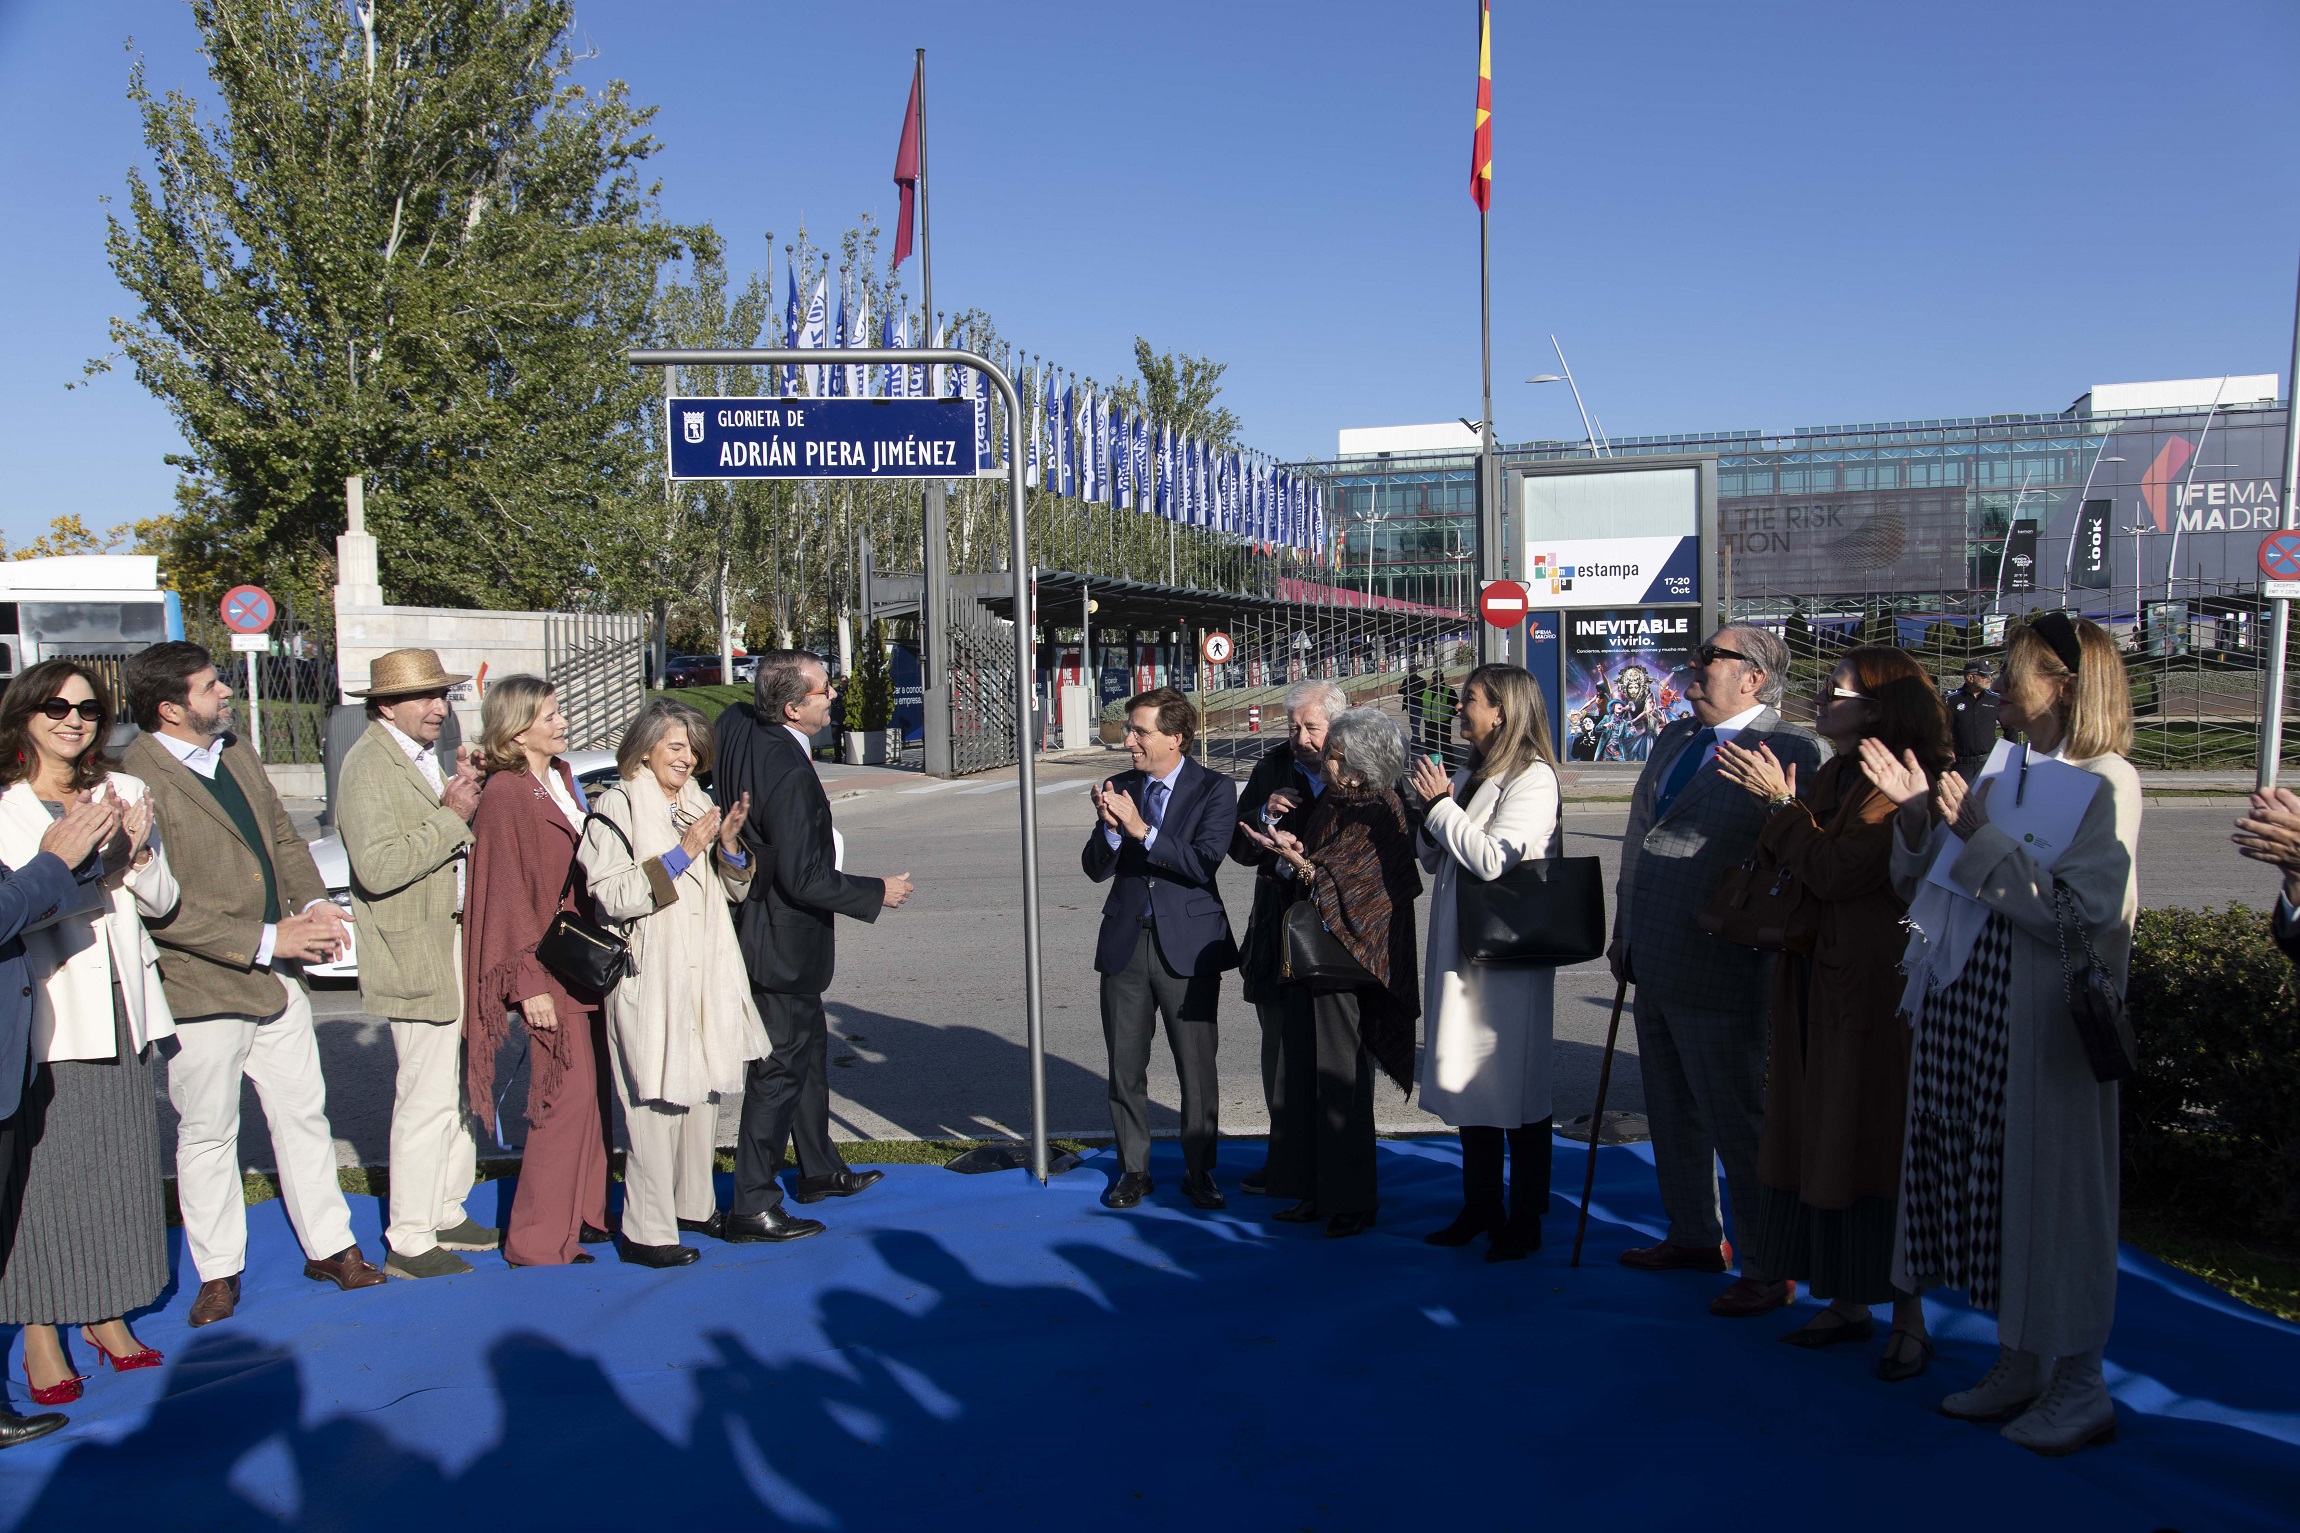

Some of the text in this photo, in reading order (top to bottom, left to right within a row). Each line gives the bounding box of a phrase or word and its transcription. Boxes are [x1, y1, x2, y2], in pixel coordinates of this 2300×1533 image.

[718, 409, 805, 428] GLORIETA DE
[719, 435, 957, 473] ADRIÁN PIERA JIMÉNEZ
[2176, 481, 2278, 507] IFEMA
[1735, 508, 1776, 531] THE
[1786, 504, 1844, 529] RISK
[2091, 518, 2103, 571] LOOK
[1578, 563, 1639, 580] estampa
[1663, 577, 1690, 586] 17-20
[1670, 586, 1691, 595] Oct
[1576, 618, 1688, 636] INEVITABLE
[1608, 635, 1655, 647] vivirlo.
